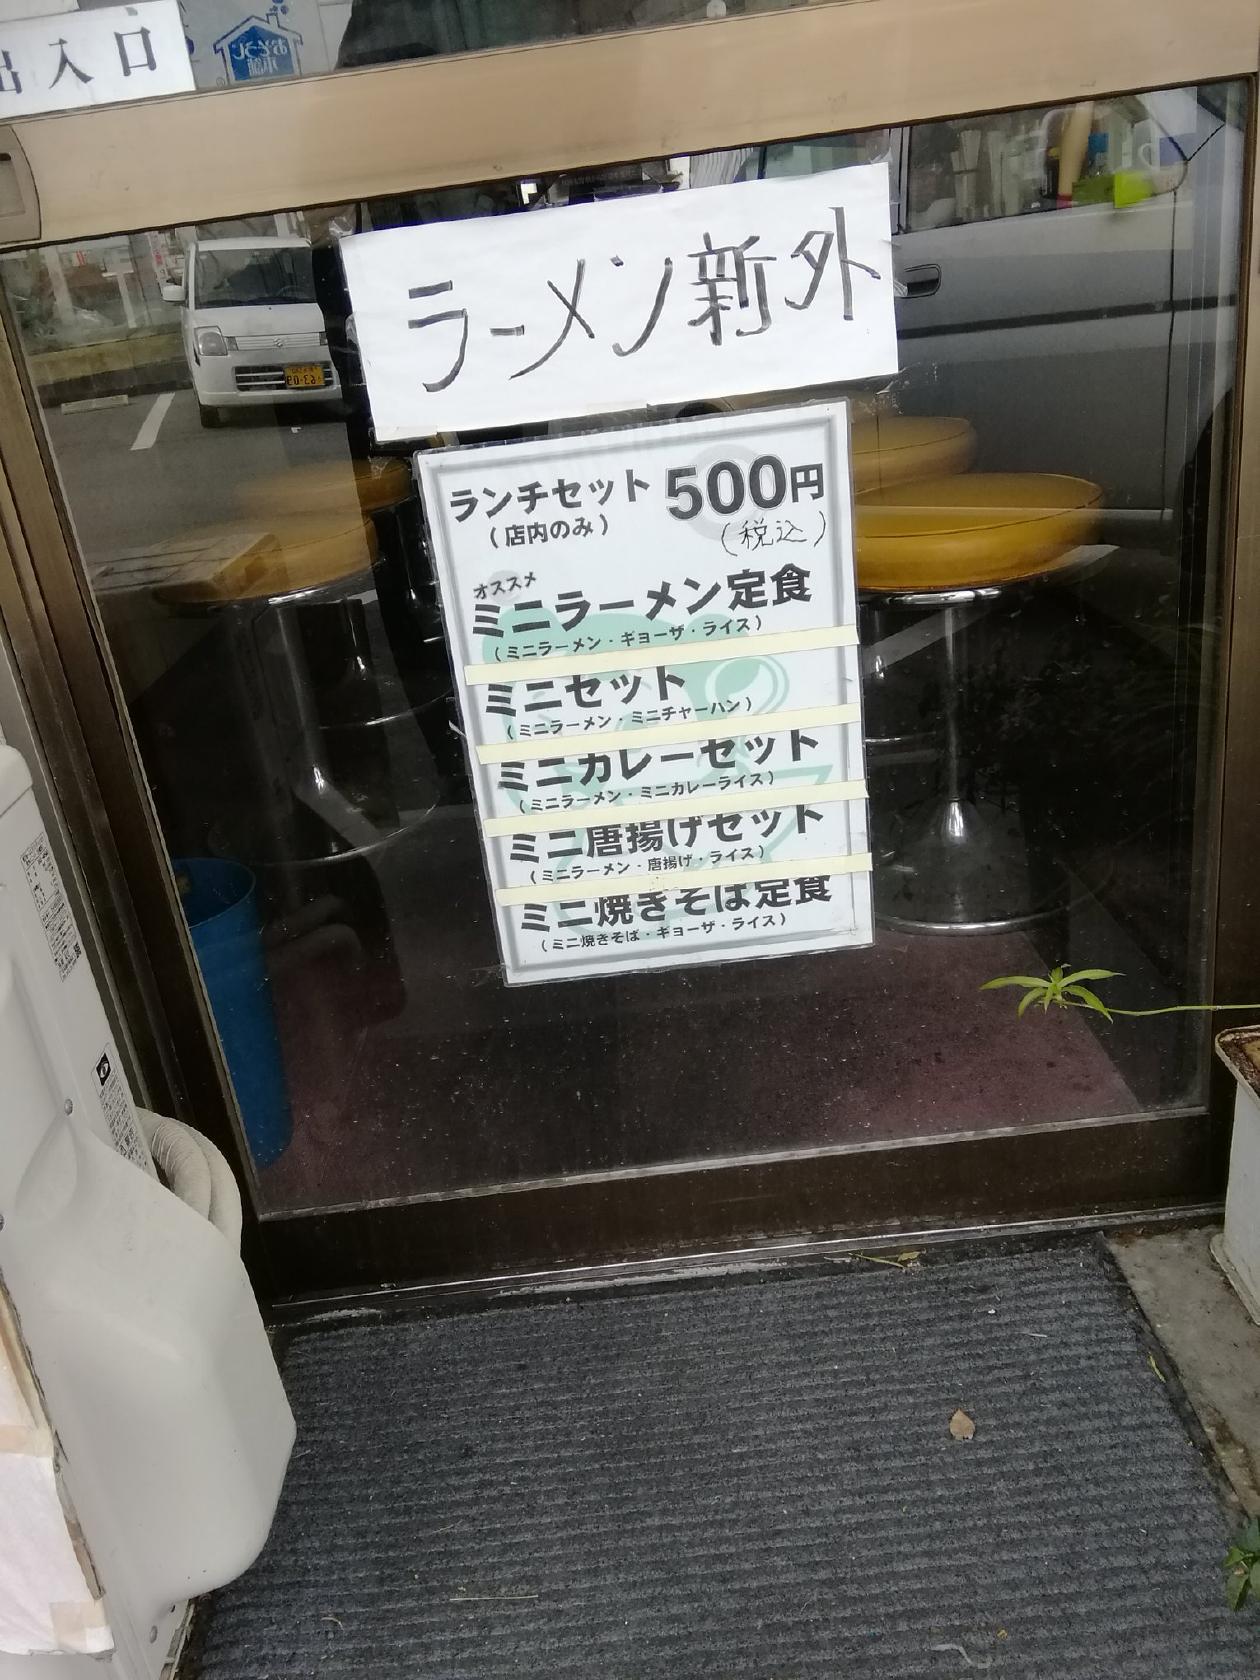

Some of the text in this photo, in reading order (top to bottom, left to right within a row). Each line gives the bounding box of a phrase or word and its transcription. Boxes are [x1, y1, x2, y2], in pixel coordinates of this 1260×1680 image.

[408, 206, 881, 392] ラーメン新外
[449, 454, 825, 522] ランチセット 500円
[472, 563, 812, 638] ミニラーメン定食
[473, 571, 537, 599] オススメ
[486, 665, 686, 717] ミニセット
[498, 729, 819, 791] ミニカレーセット
[509, 804, 824, 863] ミニ唐揚げセット
